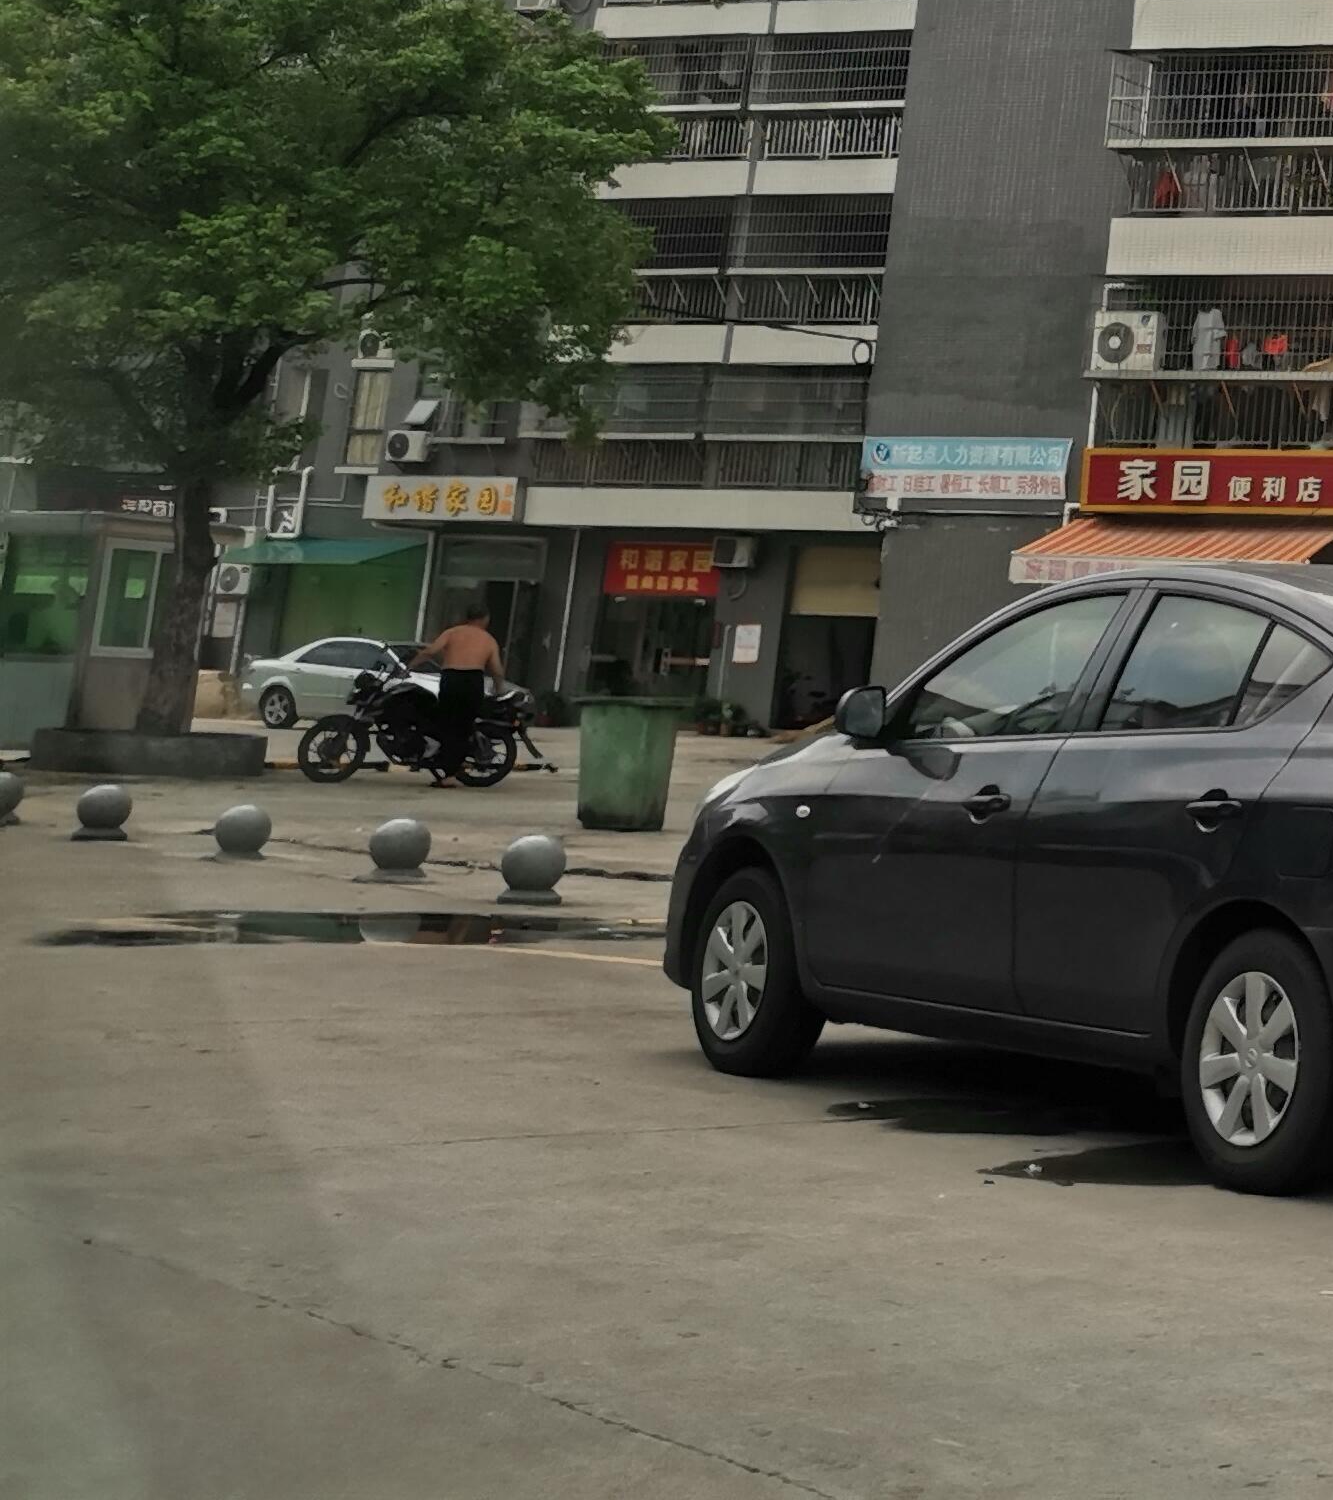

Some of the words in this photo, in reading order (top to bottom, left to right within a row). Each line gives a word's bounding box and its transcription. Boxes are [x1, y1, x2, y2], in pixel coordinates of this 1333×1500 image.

[1117, 459, 1211, 501] 家园
[1228, 475, 1322, 503] 便利店
